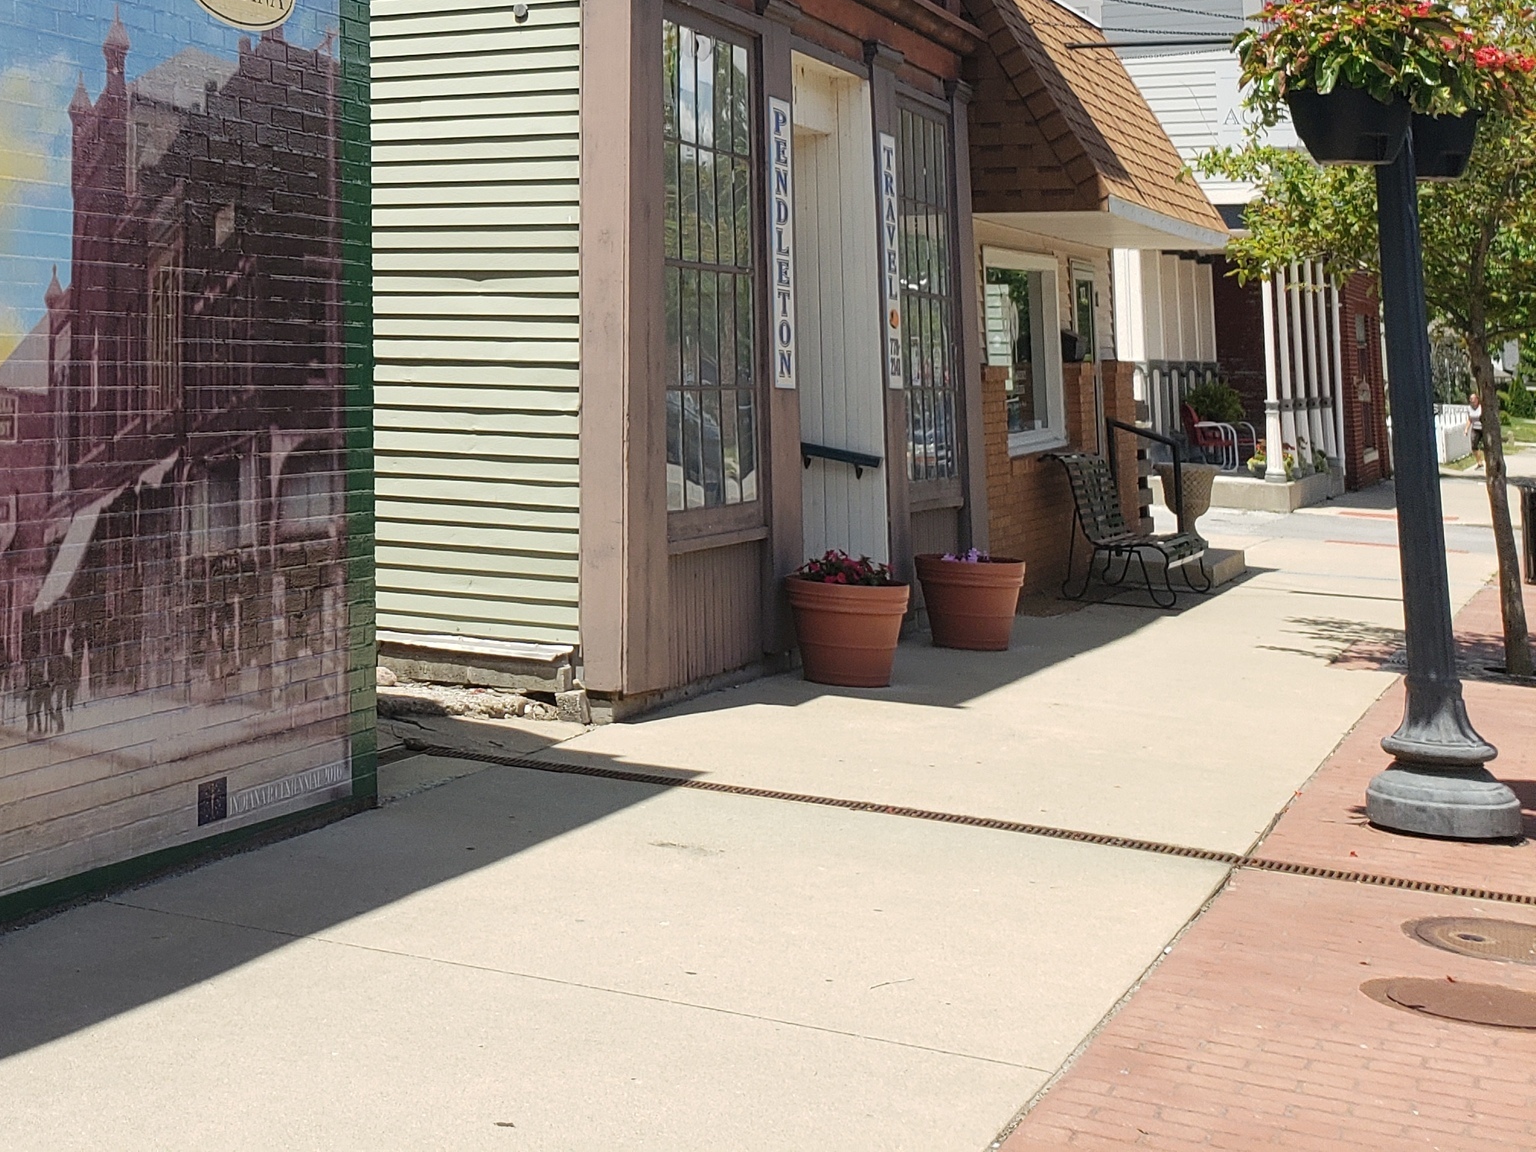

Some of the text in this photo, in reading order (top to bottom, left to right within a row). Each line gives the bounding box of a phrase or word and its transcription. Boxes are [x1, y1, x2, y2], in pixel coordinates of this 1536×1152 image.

[772, 106, 792, 379] PENDLETON
[882, 148, 898, 300] TRAVEL
[324, 765, 343, 785] 2016
